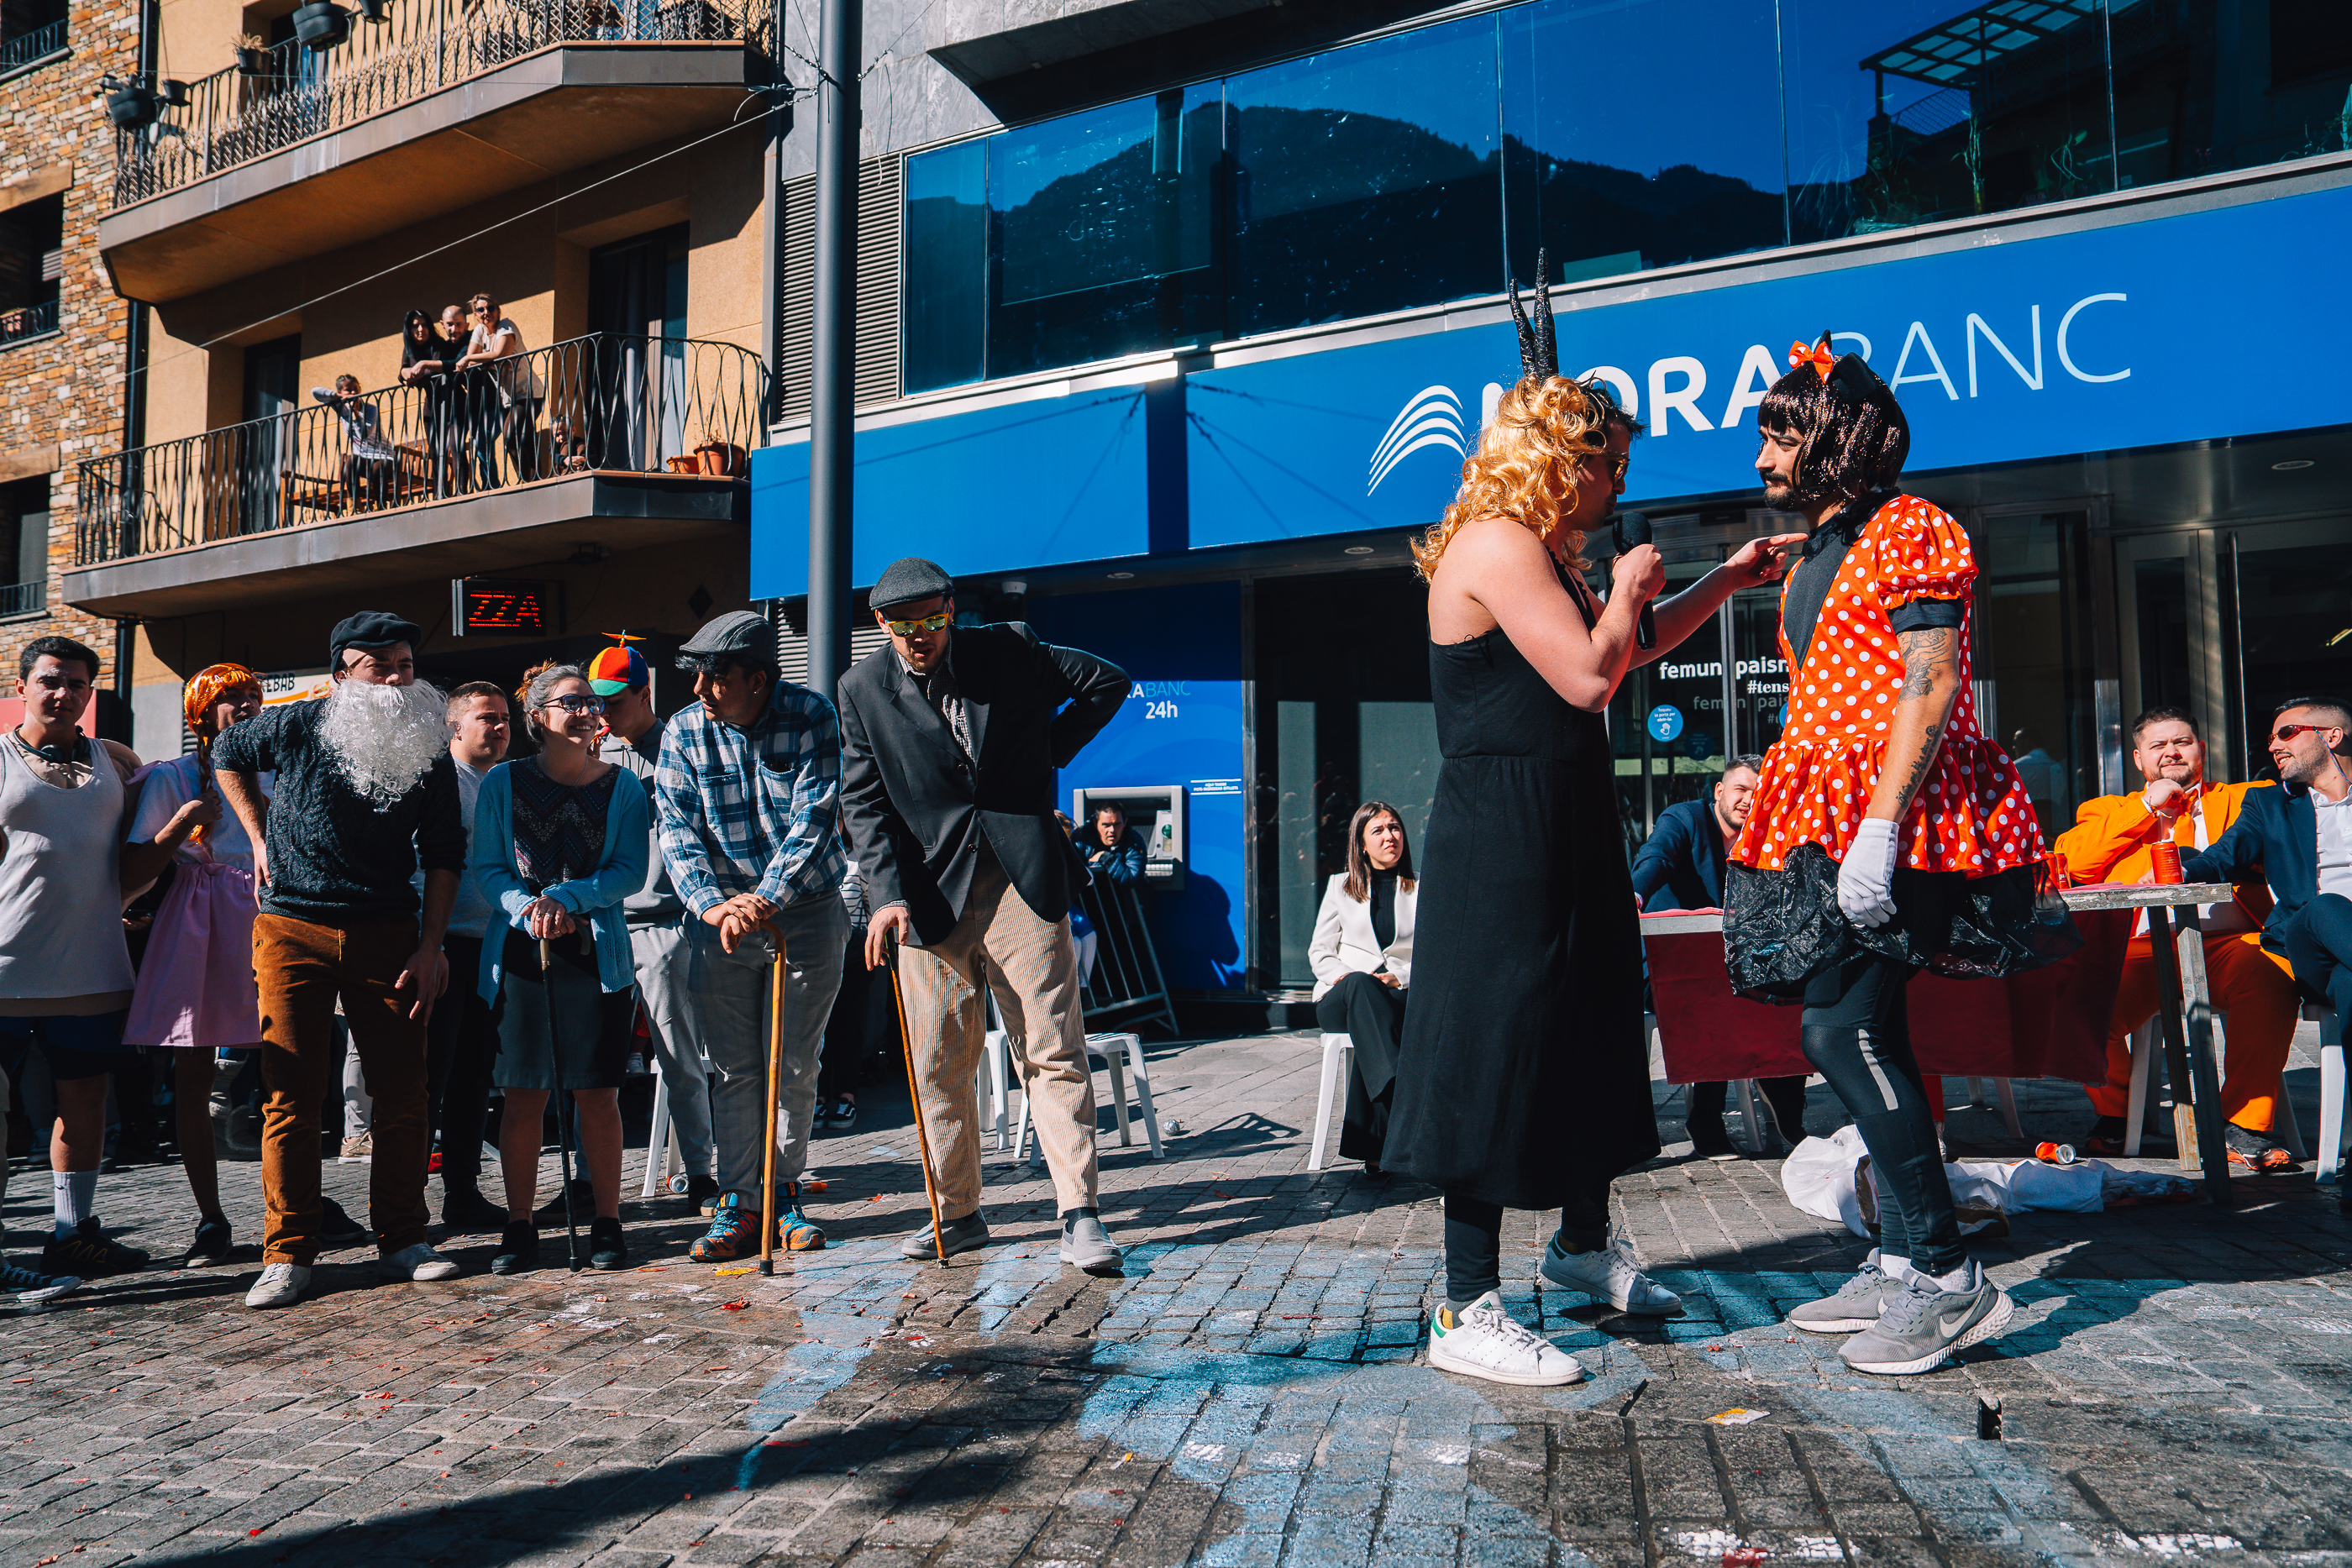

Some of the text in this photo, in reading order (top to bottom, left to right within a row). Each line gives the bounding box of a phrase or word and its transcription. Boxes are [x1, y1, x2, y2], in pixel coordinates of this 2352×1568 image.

[260, 673, 295, 692] EBAB
[1127, 680, 1191, 698] ABANC
[1146, 700, 1178, 719] 24h
